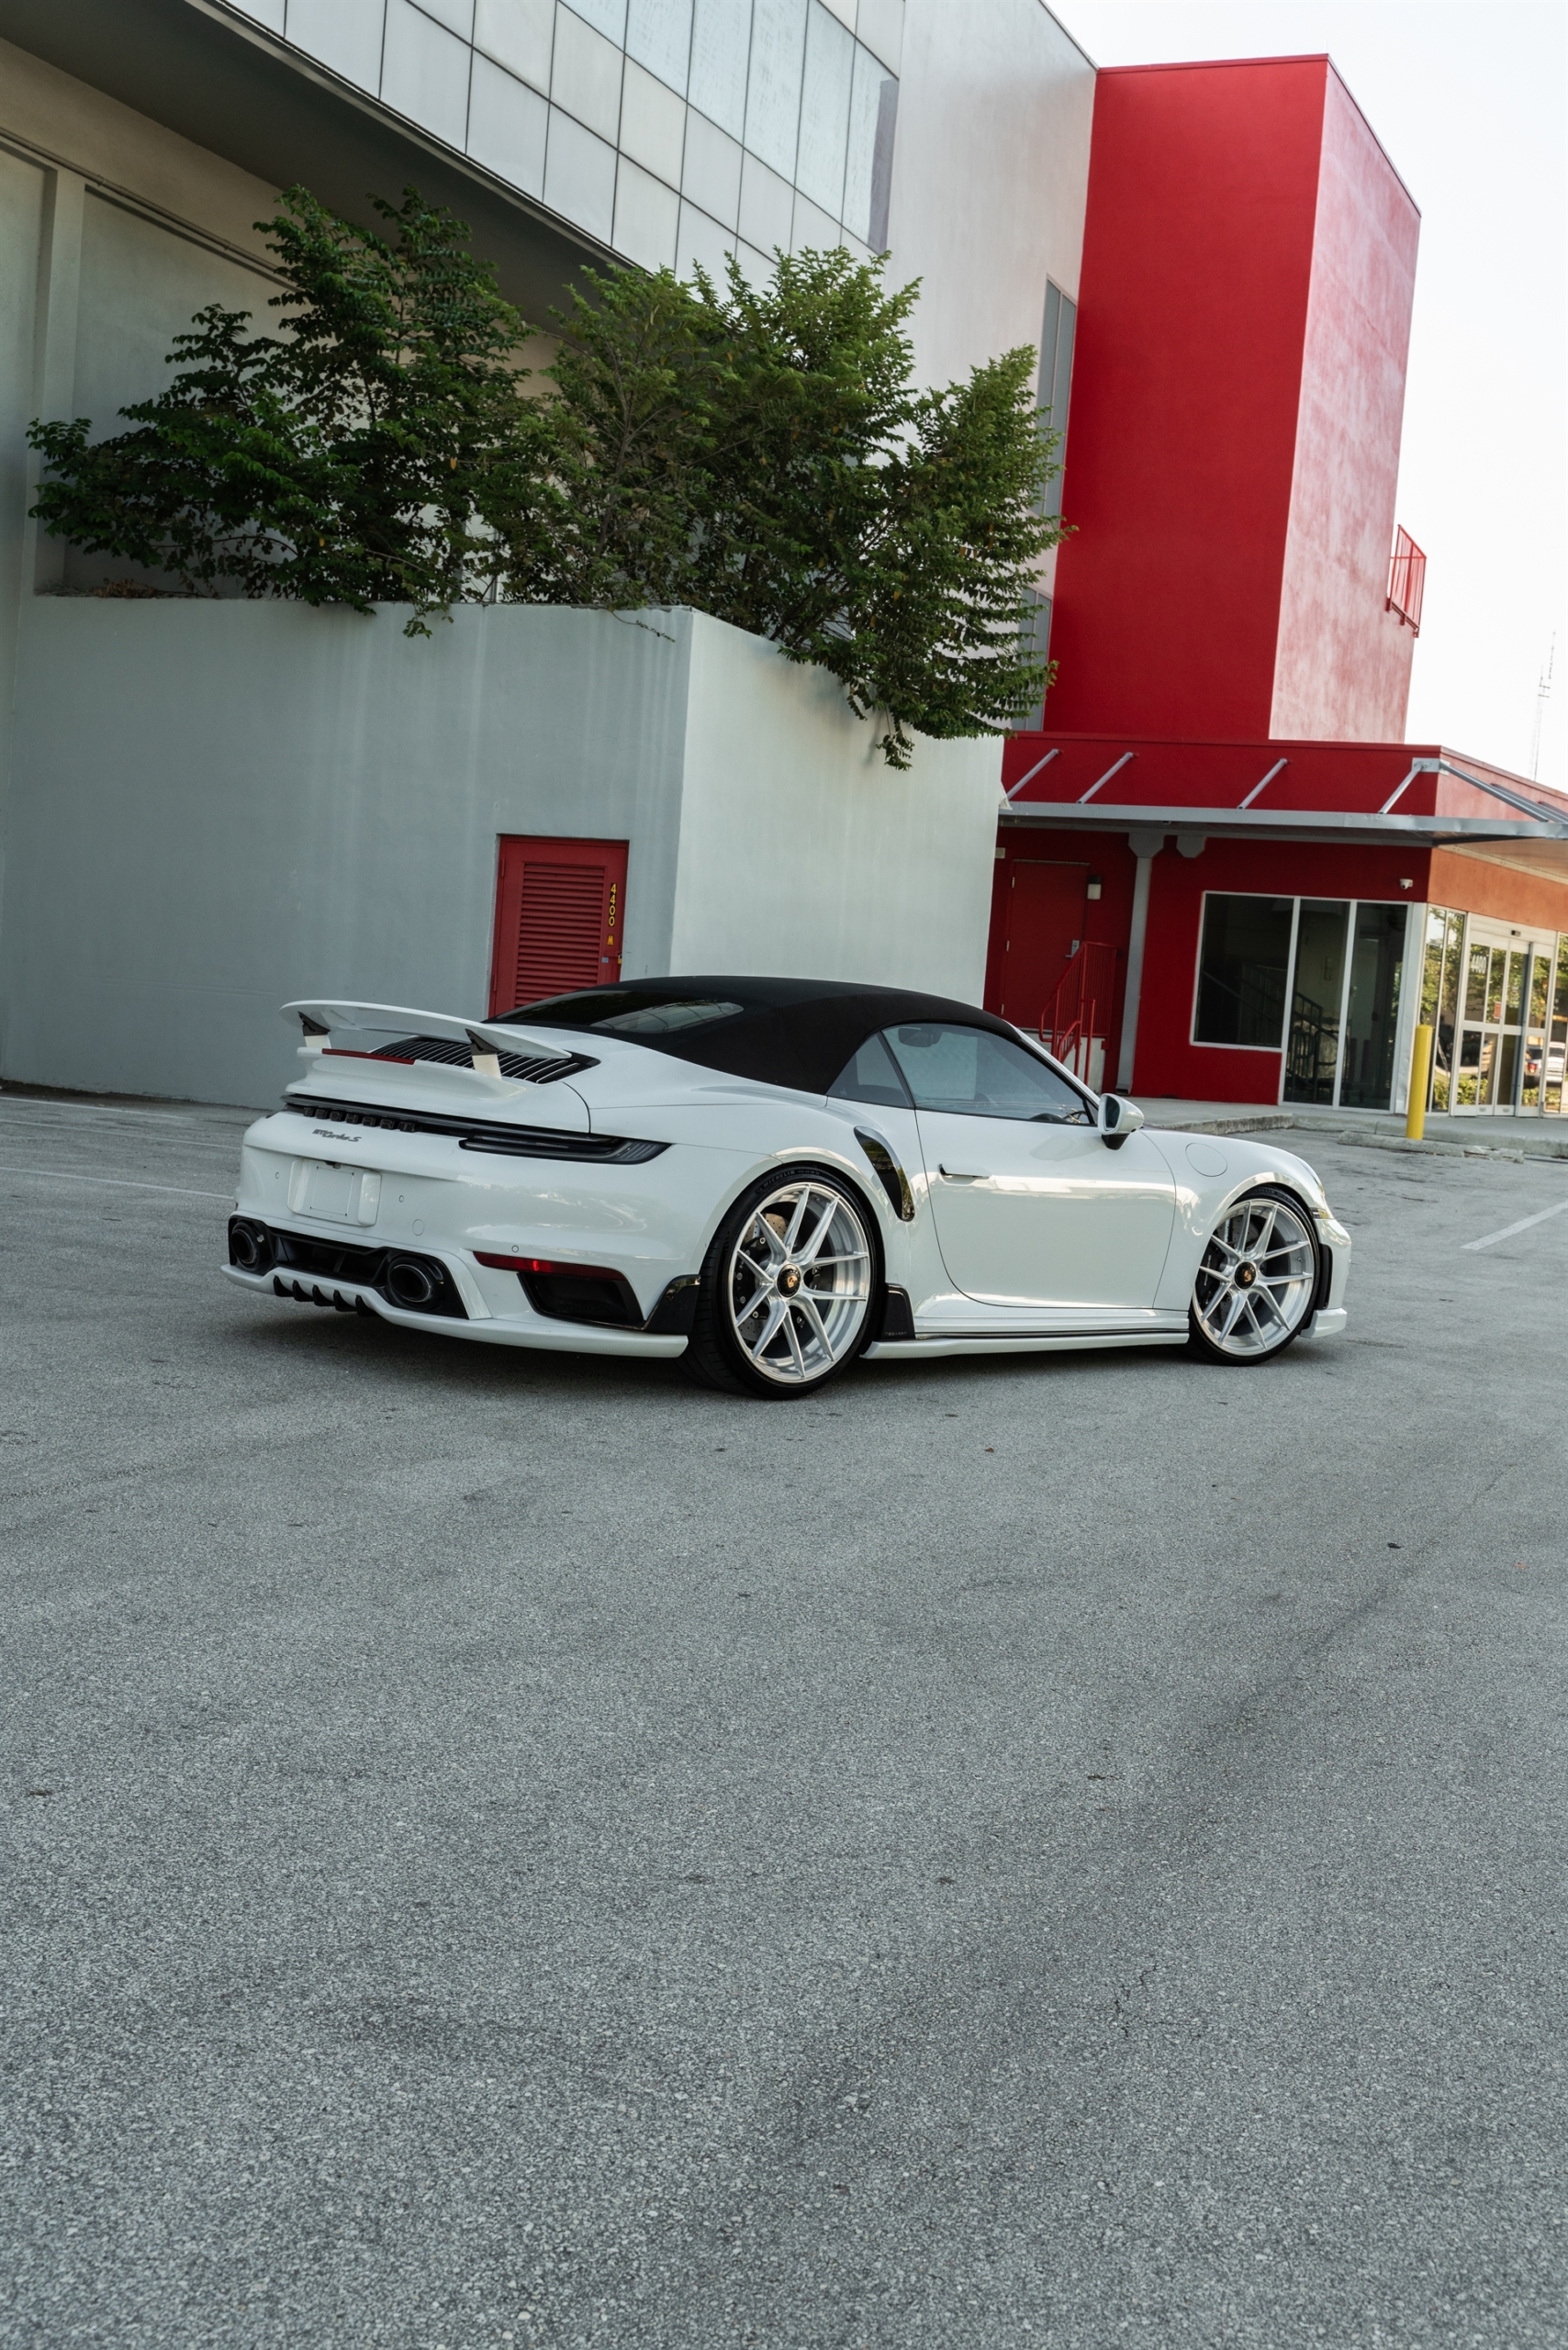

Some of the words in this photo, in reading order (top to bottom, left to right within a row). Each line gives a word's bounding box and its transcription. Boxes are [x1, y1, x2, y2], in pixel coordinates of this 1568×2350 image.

[607, 935, 613, 946] M
[303, 1107, 416, 1132] TECHART
[763, 1169, 795, 1187] MICHELIN
